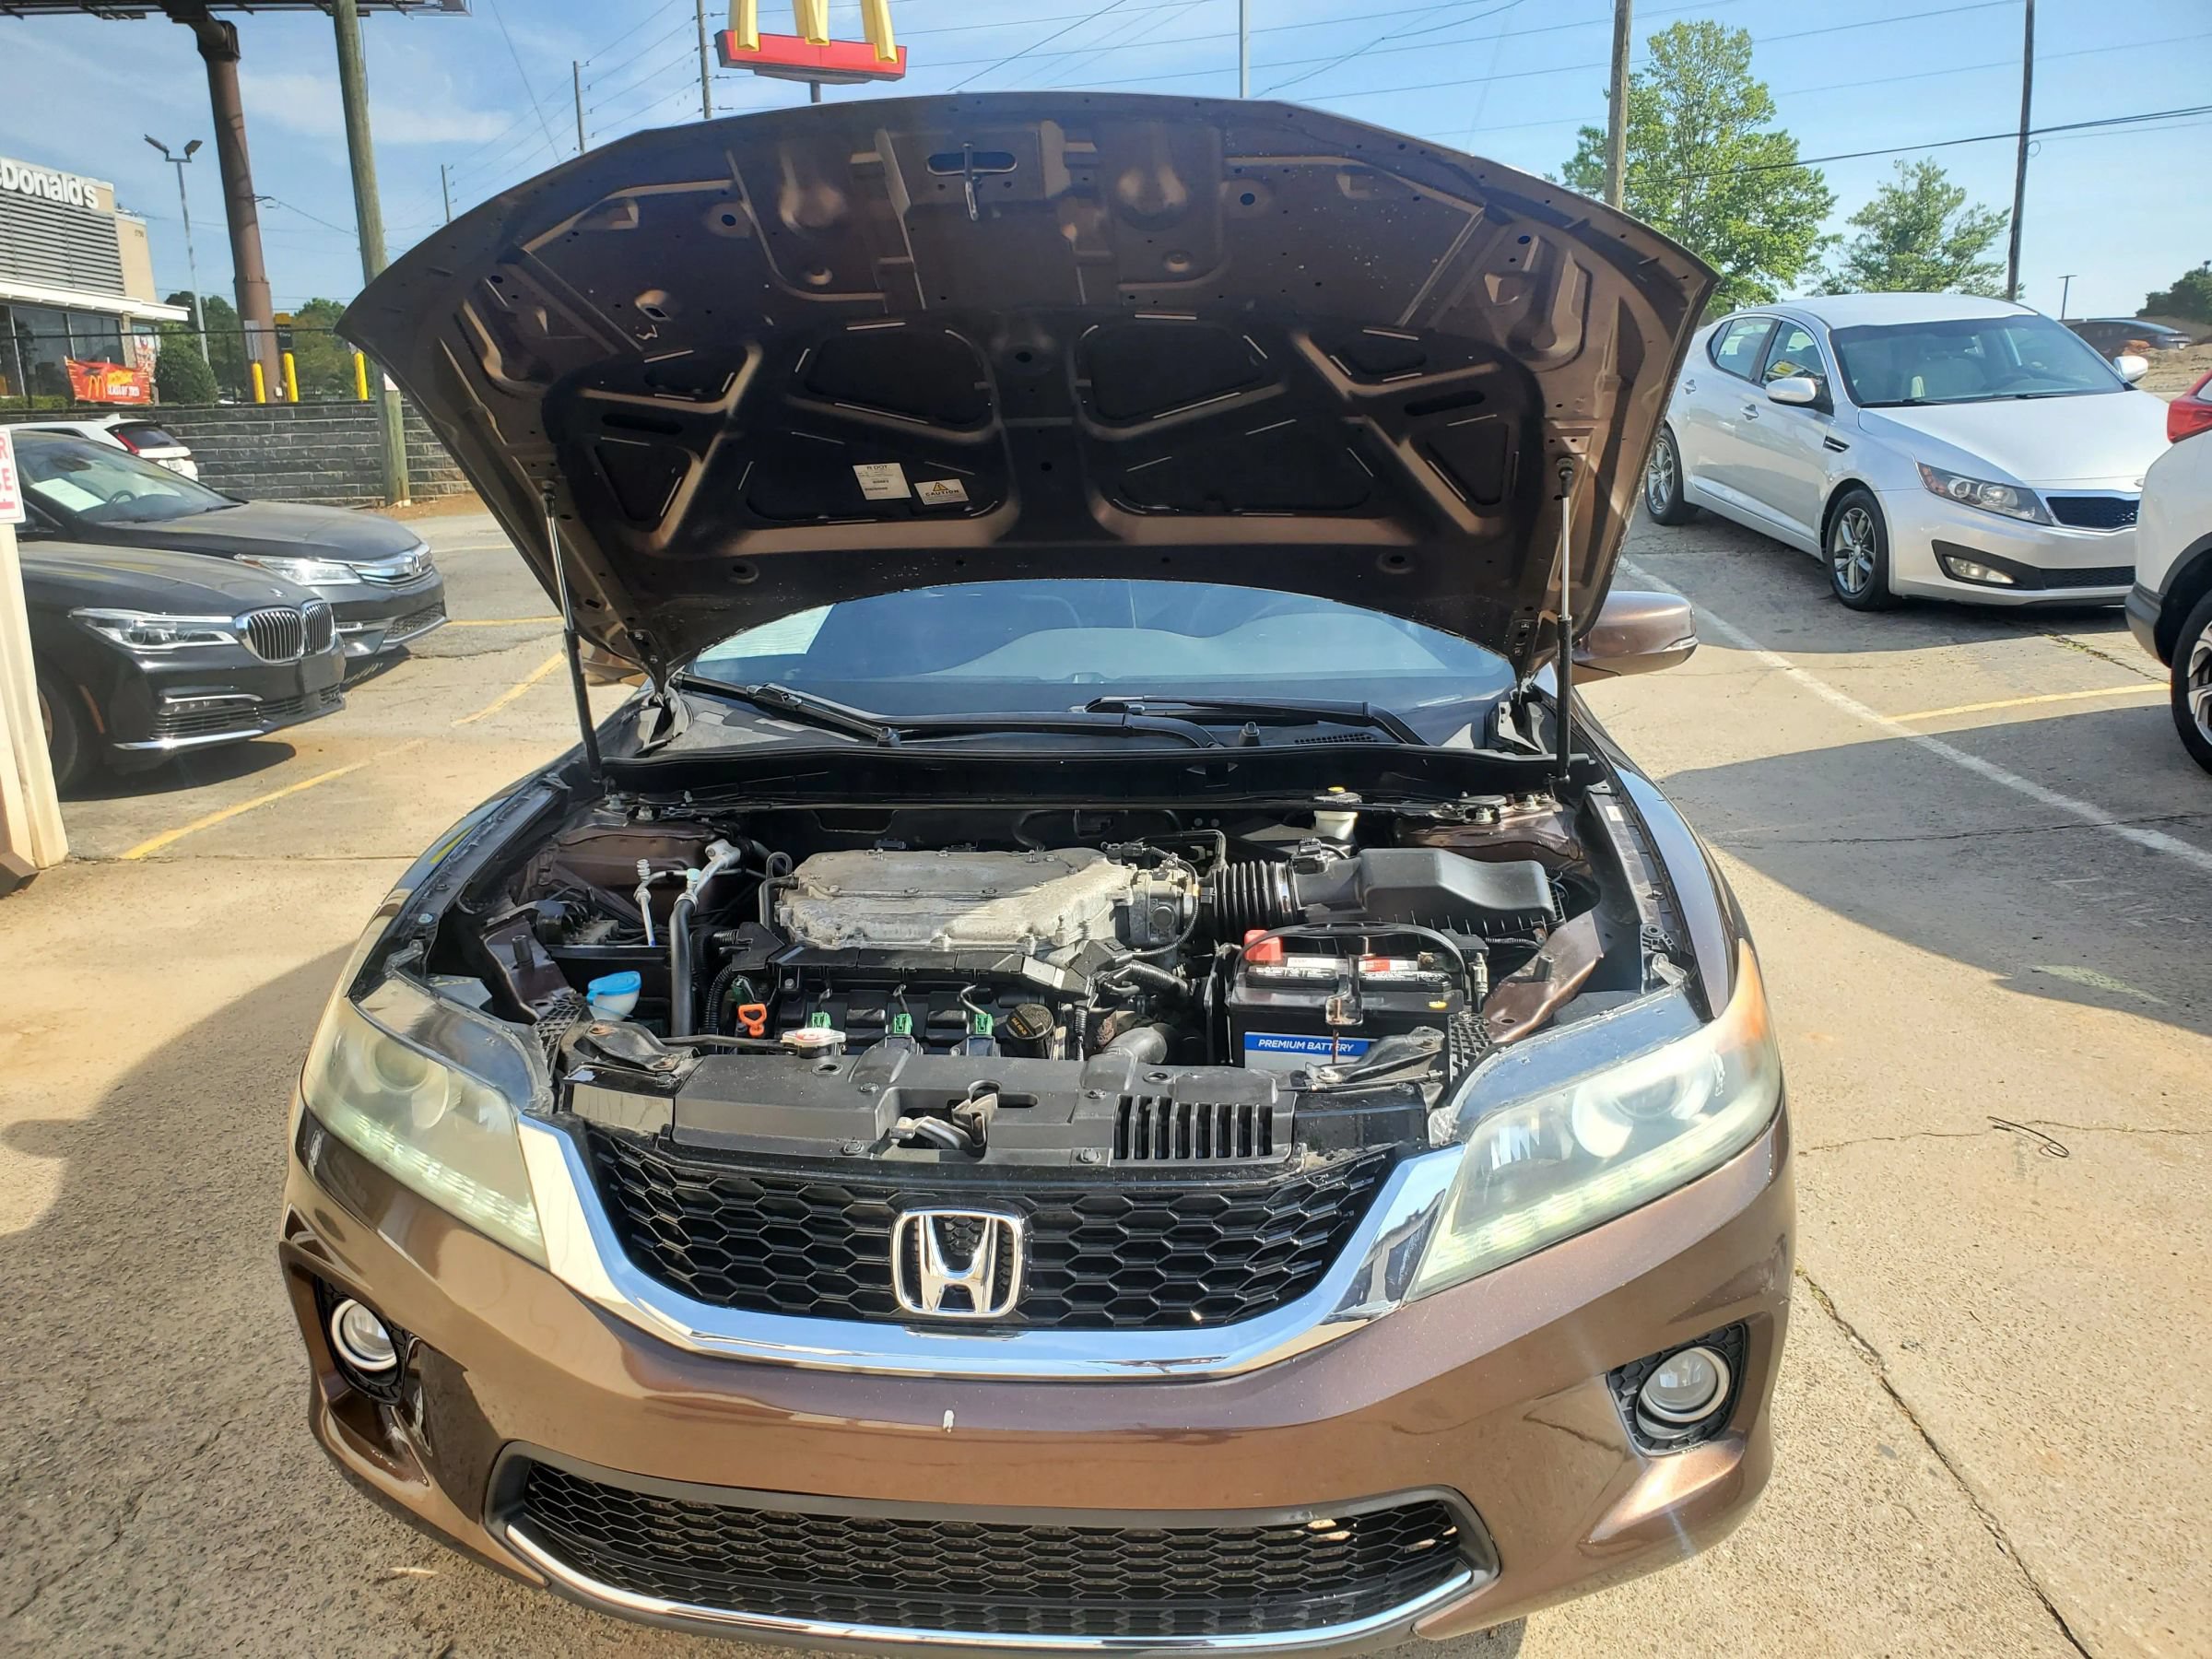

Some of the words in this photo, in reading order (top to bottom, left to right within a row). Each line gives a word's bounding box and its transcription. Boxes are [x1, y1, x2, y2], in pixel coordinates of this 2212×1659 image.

[0, 158, 99, 209] Donald's
[1258, 1039, 1306, 1050] PREMIUM
[1307, 1041, 1355, 1053] BATTERY
